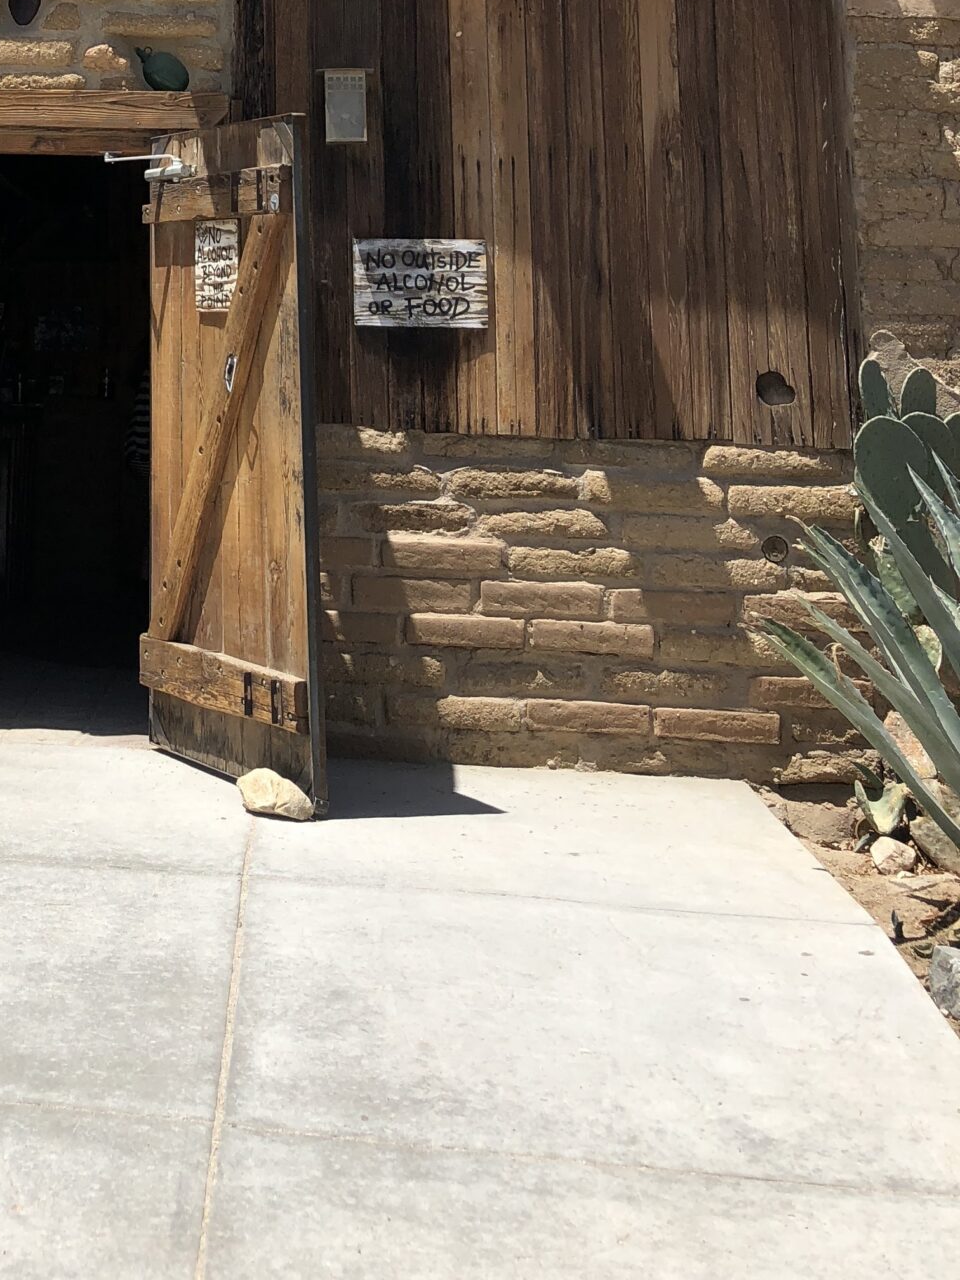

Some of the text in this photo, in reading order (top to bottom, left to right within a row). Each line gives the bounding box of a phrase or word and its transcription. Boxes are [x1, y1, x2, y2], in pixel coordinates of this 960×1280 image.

[208, 224, 222, 245] NO
[365, 248, 485, 272] NO OUTSIDE
[201, 264, 232, 280] BEYOND
[373, 272, 477, 294] ALCOHOL
[367, 296, 471, 320] OR FOOD
